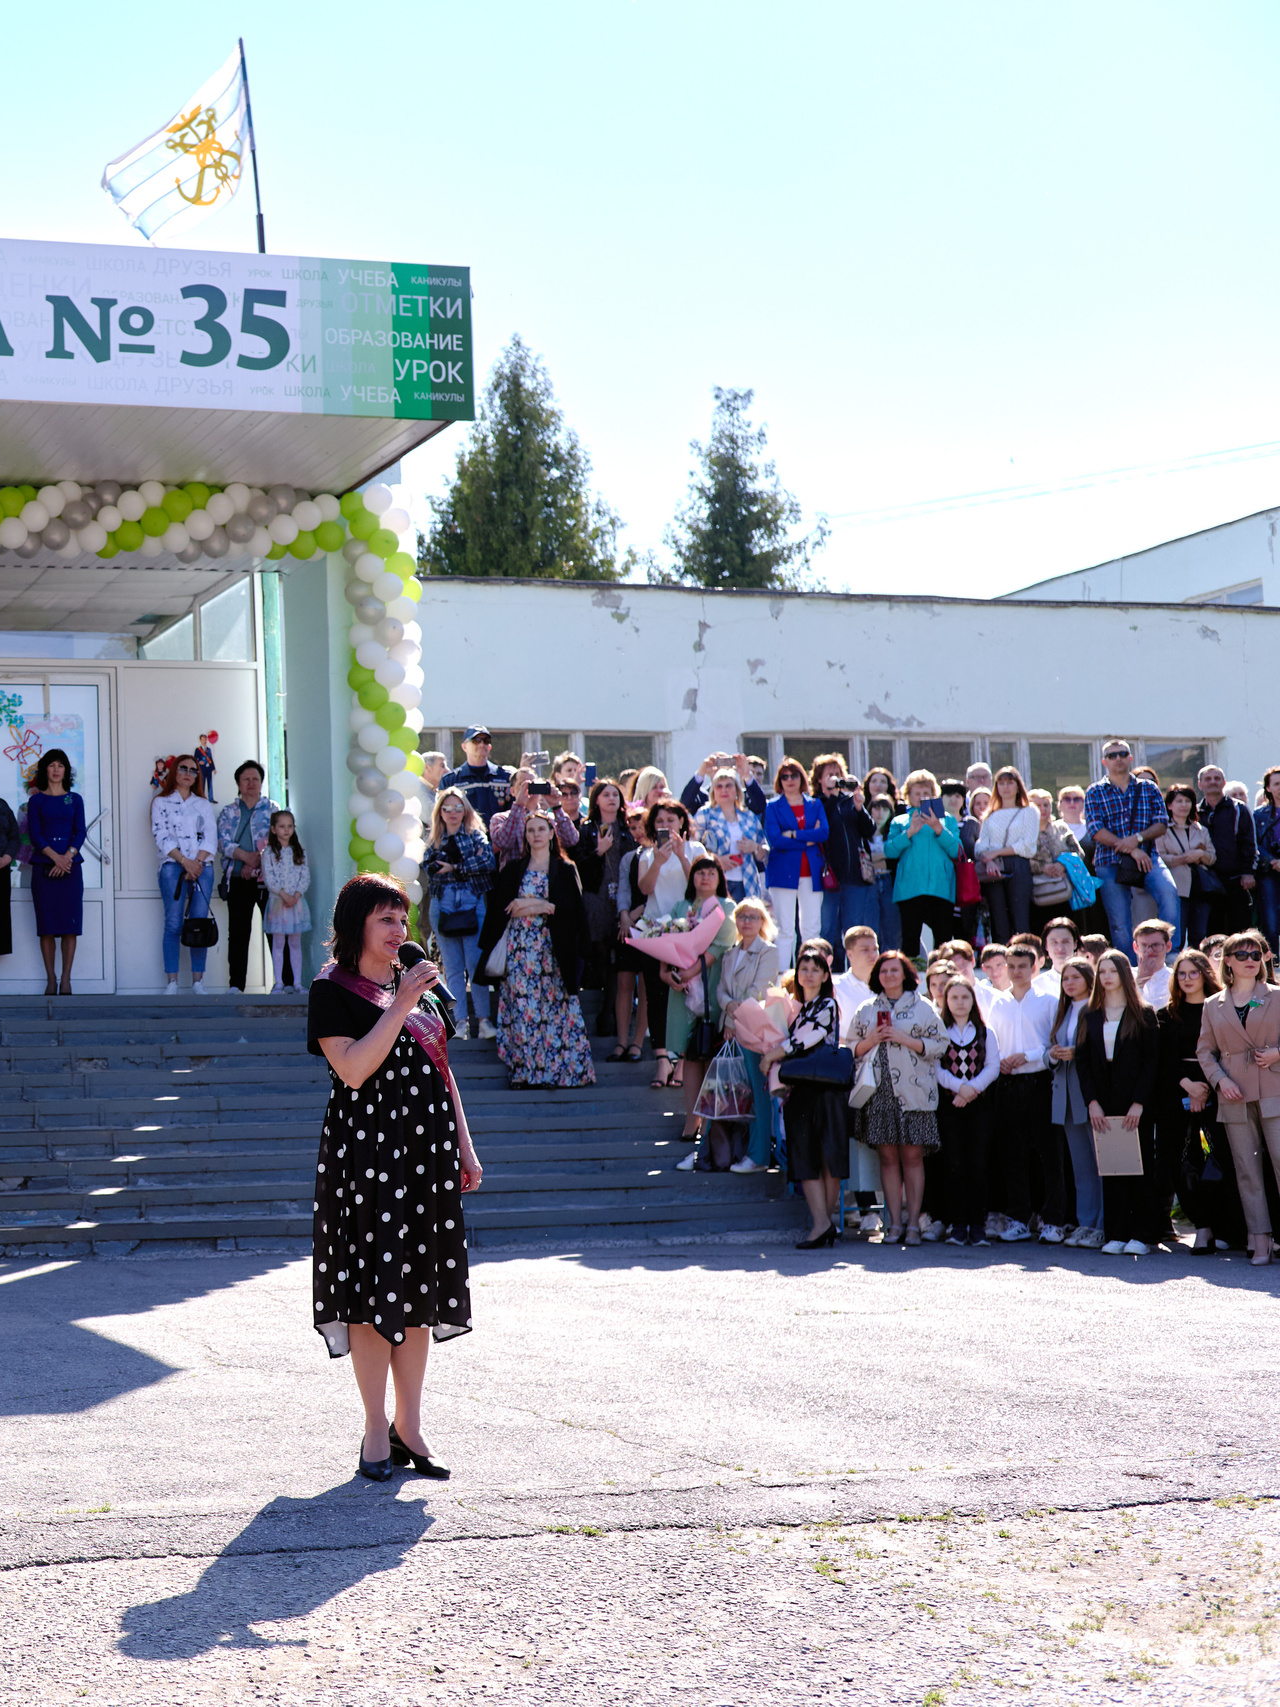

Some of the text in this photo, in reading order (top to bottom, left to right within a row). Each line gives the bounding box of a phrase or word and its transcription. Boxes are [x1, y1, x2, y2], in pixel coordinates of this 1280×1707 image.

[86, 258, 147, 273] ШКОЛА
[152, 257, 232, 278] ДРУЗЬЯ
[281, 268, 329, 281] ШКОЛА
[337, 268, 399, 288] УЧЕБА
[411, 276, 462, 288] КАНИКУЛЫ
[341, 292, 463, 320] ОТМЕТКИ
[45, 294, 155, 363] №
[179, 283, 291, 371] 35
[325, 327, 464, 351] ОБРАЗОВАНИЕ
[394, 358, 465, 384] УРОК
[87, 376, 149, 392] ШКОЛА
[154, 376, 234, 397] ДРУЗЬЯ
[283, 385, 332, 399] ШКОЛА
[340, 385, 402, 404] УЧЕБА
[413, 391, 465, 403] КАНИКУЛЫ
